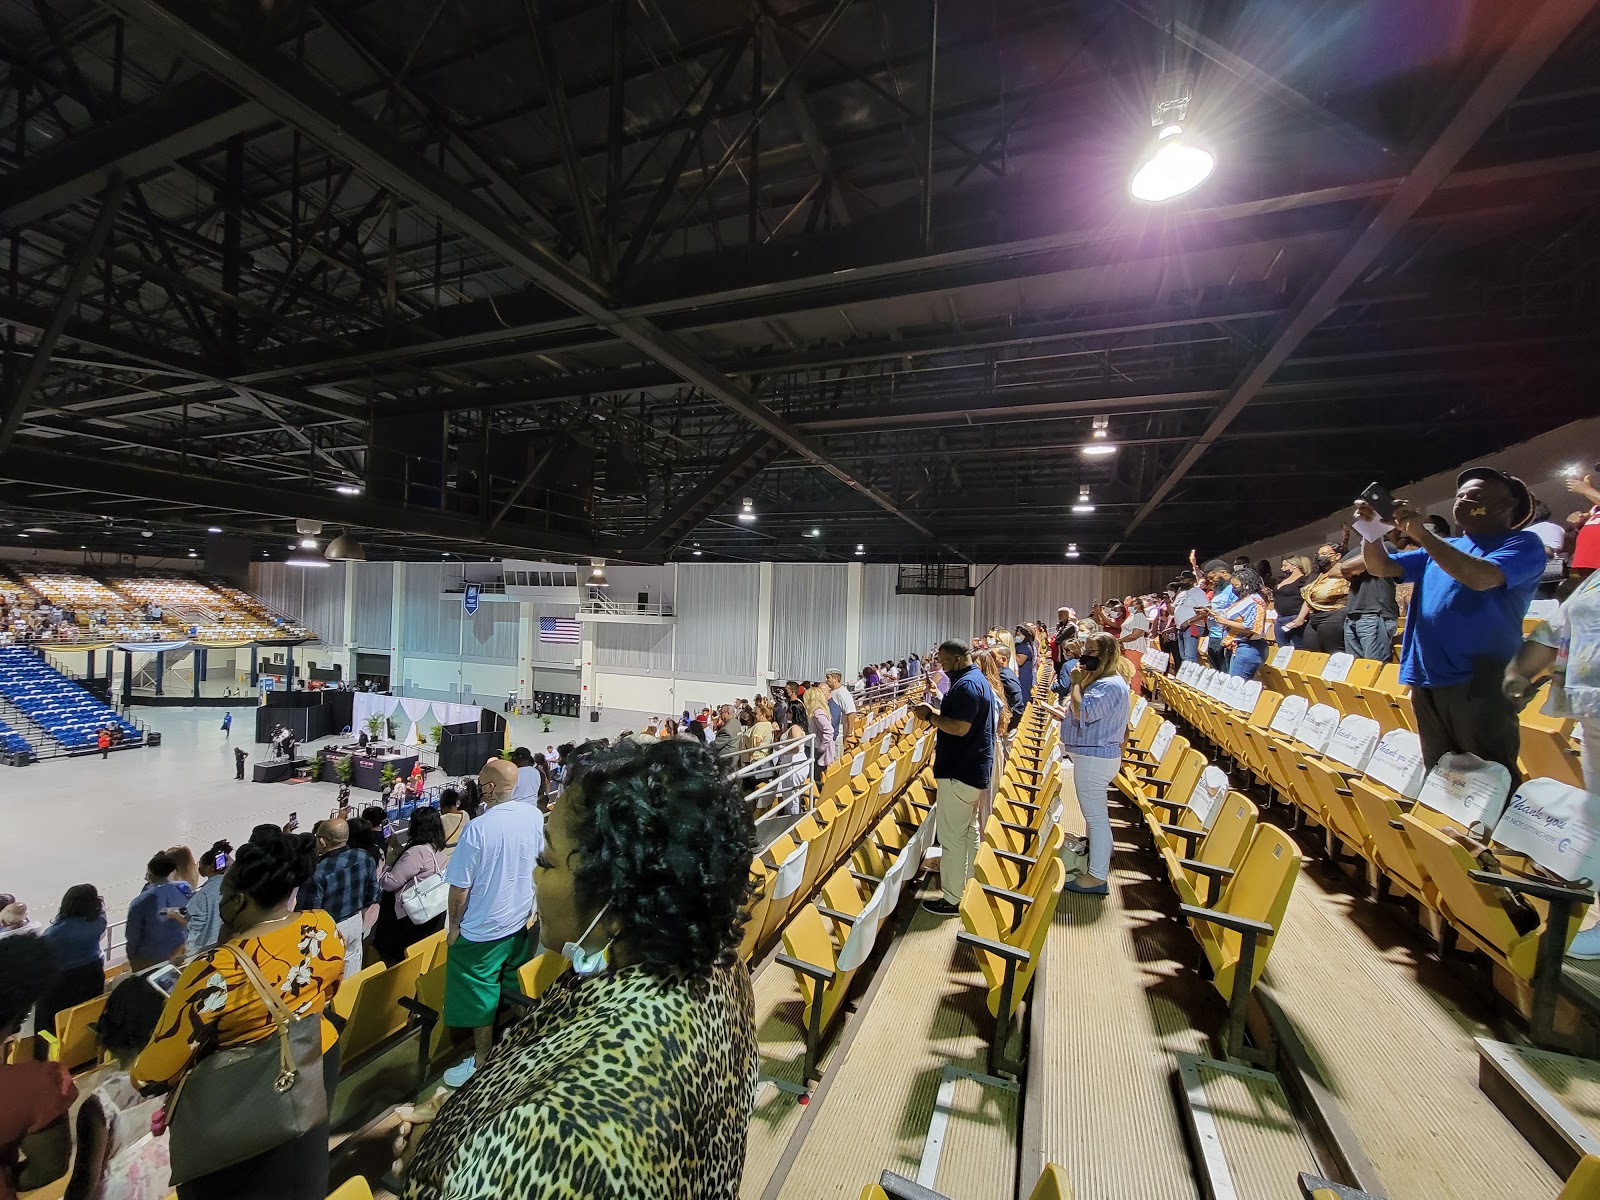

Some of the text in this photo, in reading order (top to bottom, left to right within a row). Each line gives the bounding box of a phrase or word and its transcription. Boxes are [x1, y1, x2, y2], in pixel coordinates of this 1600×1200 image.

[1508, 793, 1544, 820] Thank
[1544, 815, 1567, 829] you
[1510, 818, 1524, 827] NOT
